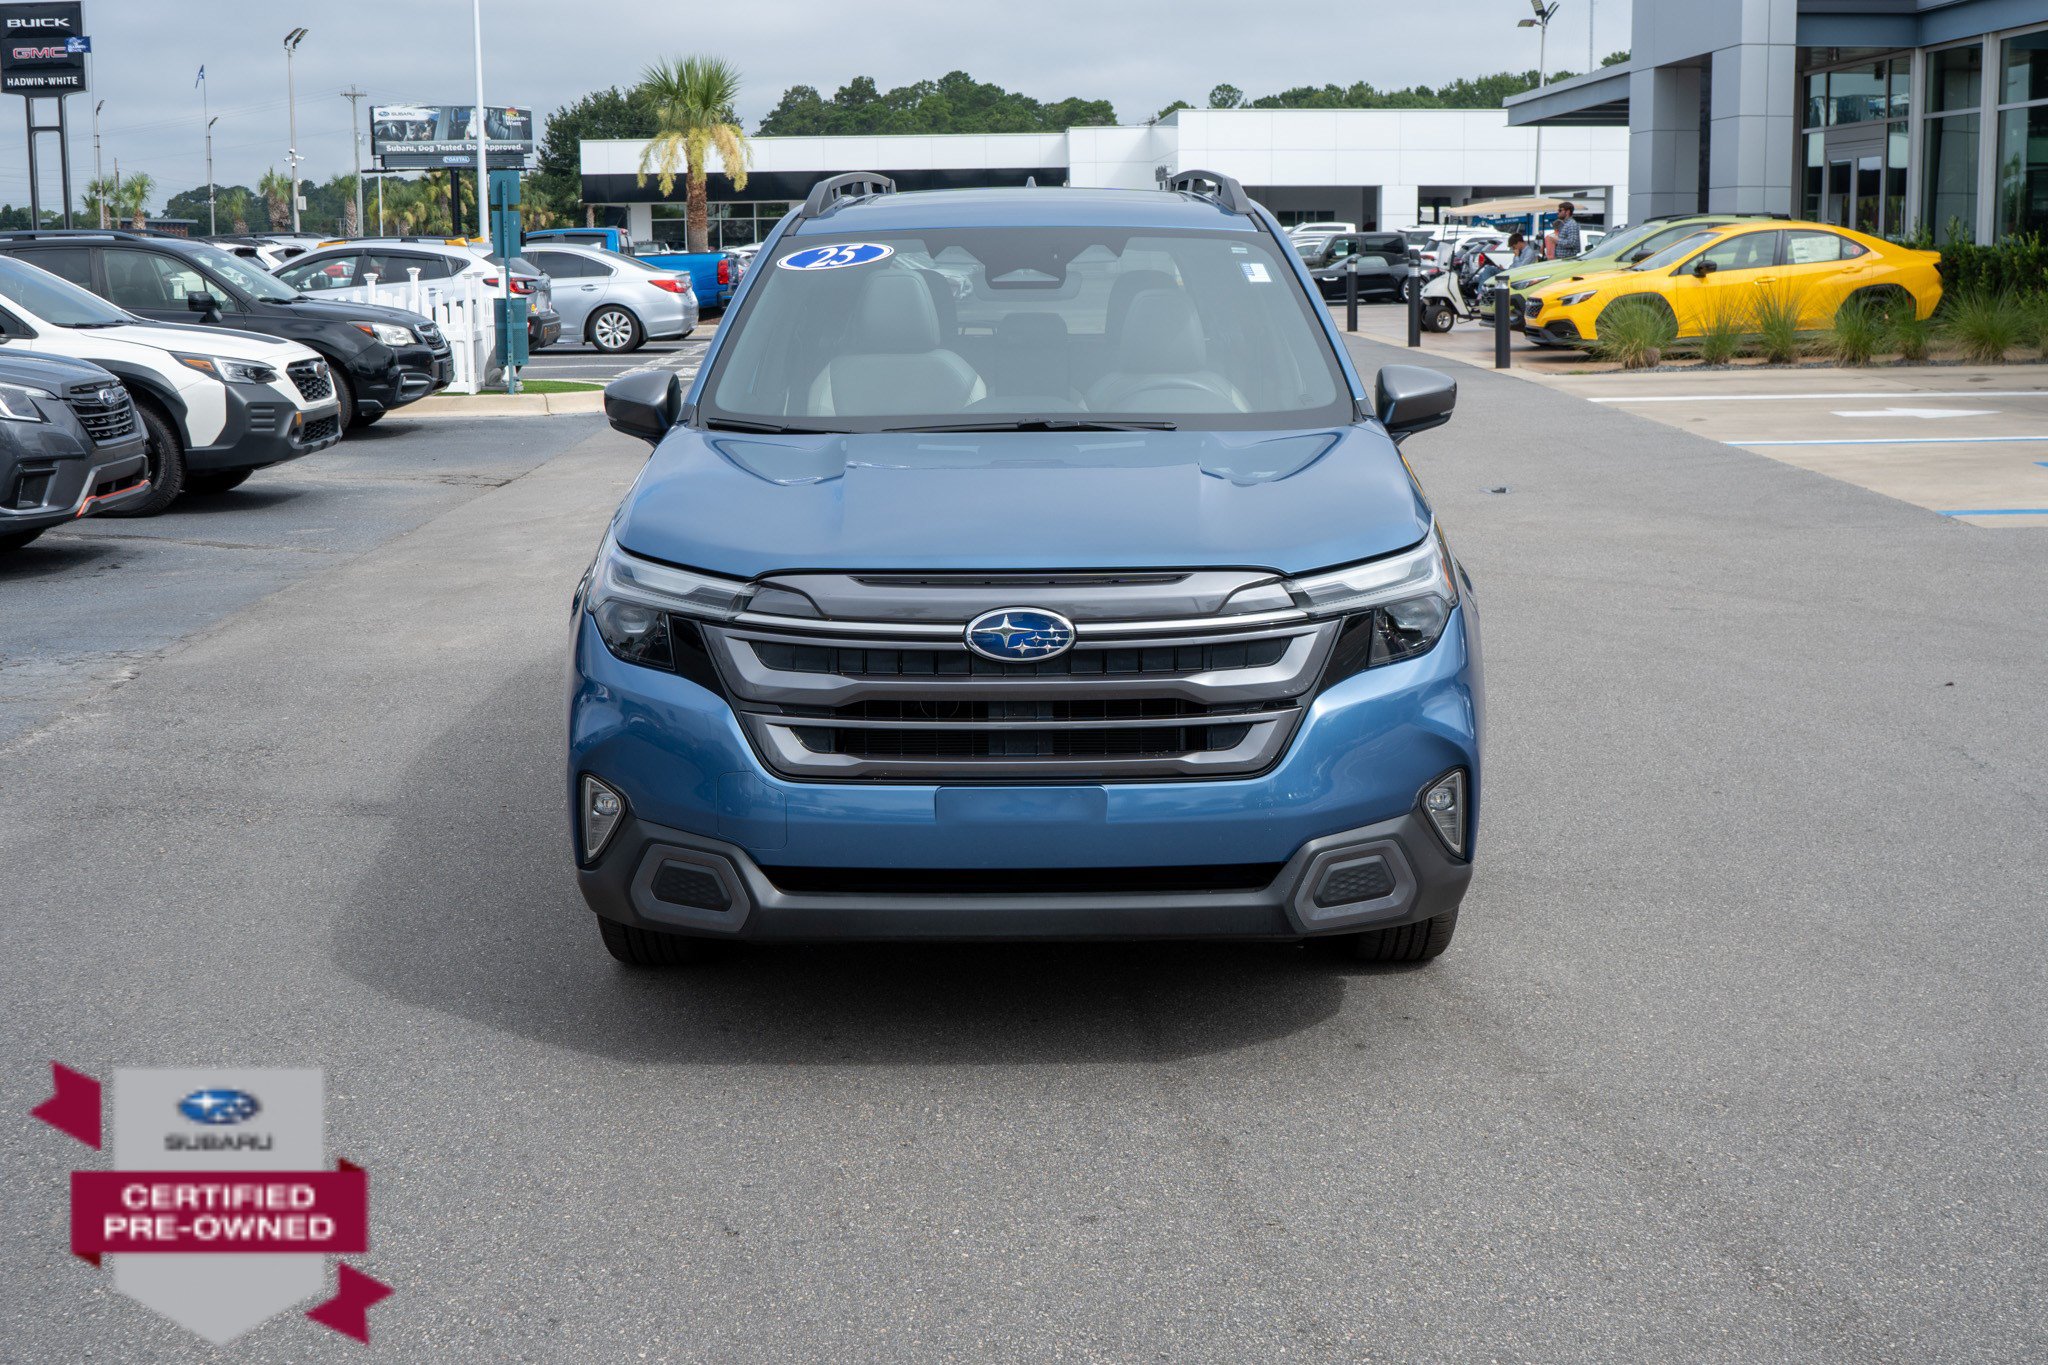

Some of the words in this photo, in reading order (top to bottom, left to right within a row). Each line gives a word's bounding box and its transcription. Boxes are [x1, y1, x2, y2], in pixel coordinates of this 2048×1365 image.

[6, 18, 71, 28] BUICK
[13, 46, 68, 59] GMC
[7, 76, 79, 87] HADWIN-WHITE
[386, 144, 417, 152] Subaru,
[418, 144, 435, 153] Dog
[466, 143, 478, 151] Do
[484, 143, 524, 152] Approved.
[805, 244, 865, 269] 25
